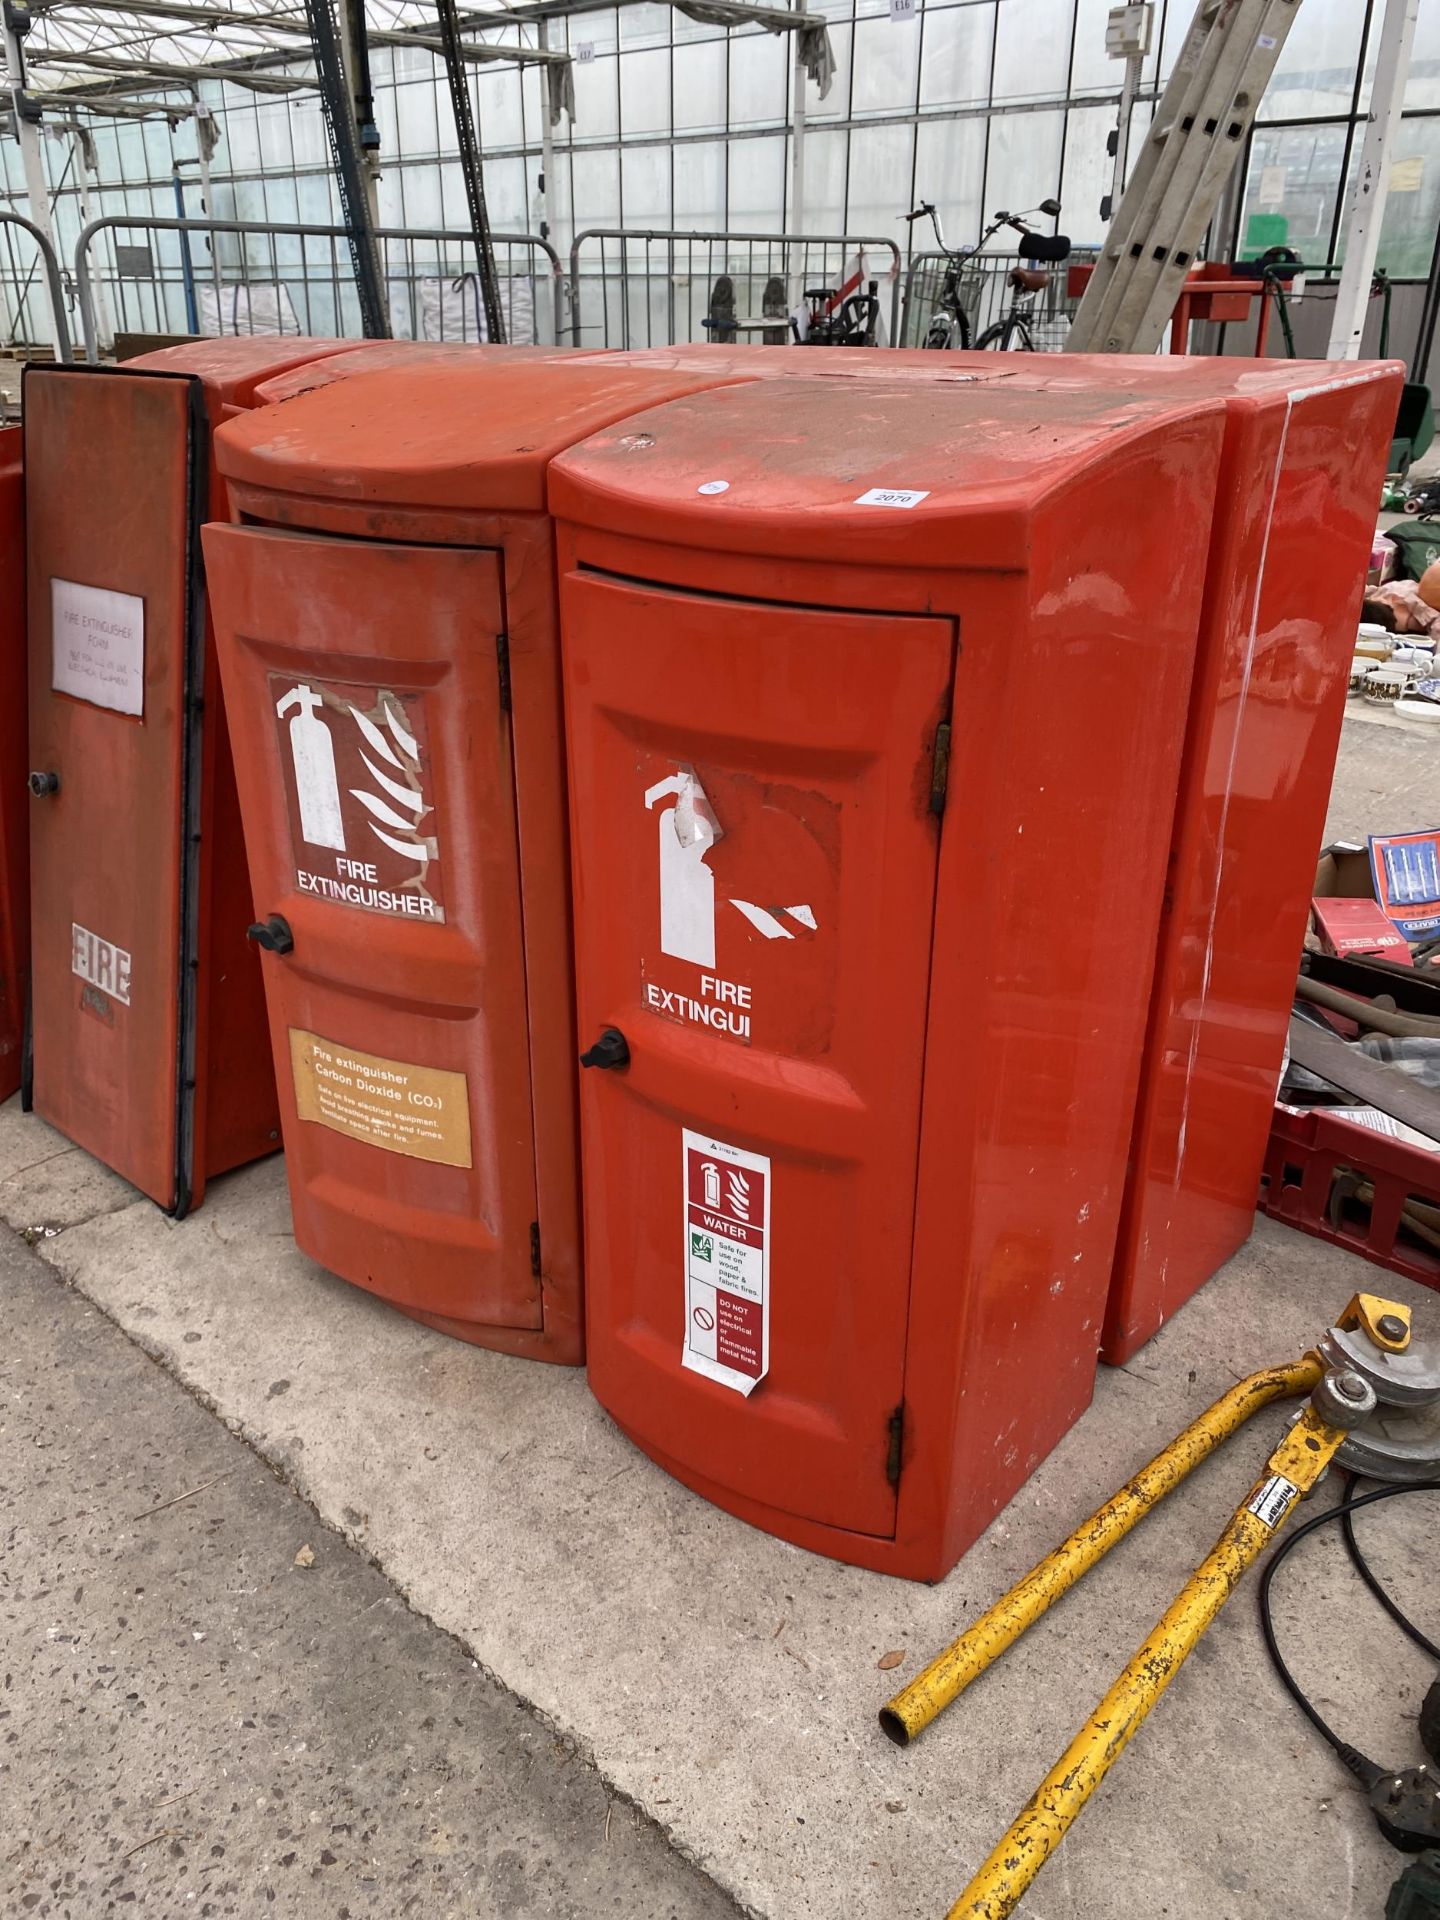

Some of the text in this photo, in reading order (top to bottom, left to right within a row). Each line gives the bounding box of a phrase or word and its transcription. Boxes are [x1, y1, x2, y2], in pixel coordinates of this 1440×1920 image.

[874, 494, 912, 503] 2070
[336, 857, 378, 883] FIRE
[297, 870, 435, 916] EXTINGUISHER
[74, 926, 130, 1001] FIRE
[701, 974, 752, 1009] FIRE
[647, 983, 751, 1037] EXTINGUI
[313, 1045, 408, 1085] Fire extinguisher
[315, 1063, 352, 1086] Carbon
[356, 1078, 402, 1101] Dioxide
[318, 1084, 439, 1128] Safe on live electrical equipment.
[320, 1096, 336, 1108] Avoid
[337, 1102, 370, 1122] breathing
[399, 1123, 414, 1134] and
[416, 1127, 444, 1140] fumes.
[320, 1106, 409, 1144] Ventilate space after fire.
[703, 1214, 747, 1240] WATER
[704, 1238, 711, 1247] A
[719, 1241, 747, 1257] Safe for
[719, 1252, 743, 1265] use on
[719, 1269, 740, 1281] paper
[719, 1276, 759, 1297] fabric fires.
[720, 1299, 748, 1315] DO NOT
[720, 1309, 743, 1323] use on
[720, 1318, 752, 1335] electrical
[720, 1336, 757, 1356] flammable
[720, 1346, 758, 1366] metal fires.
